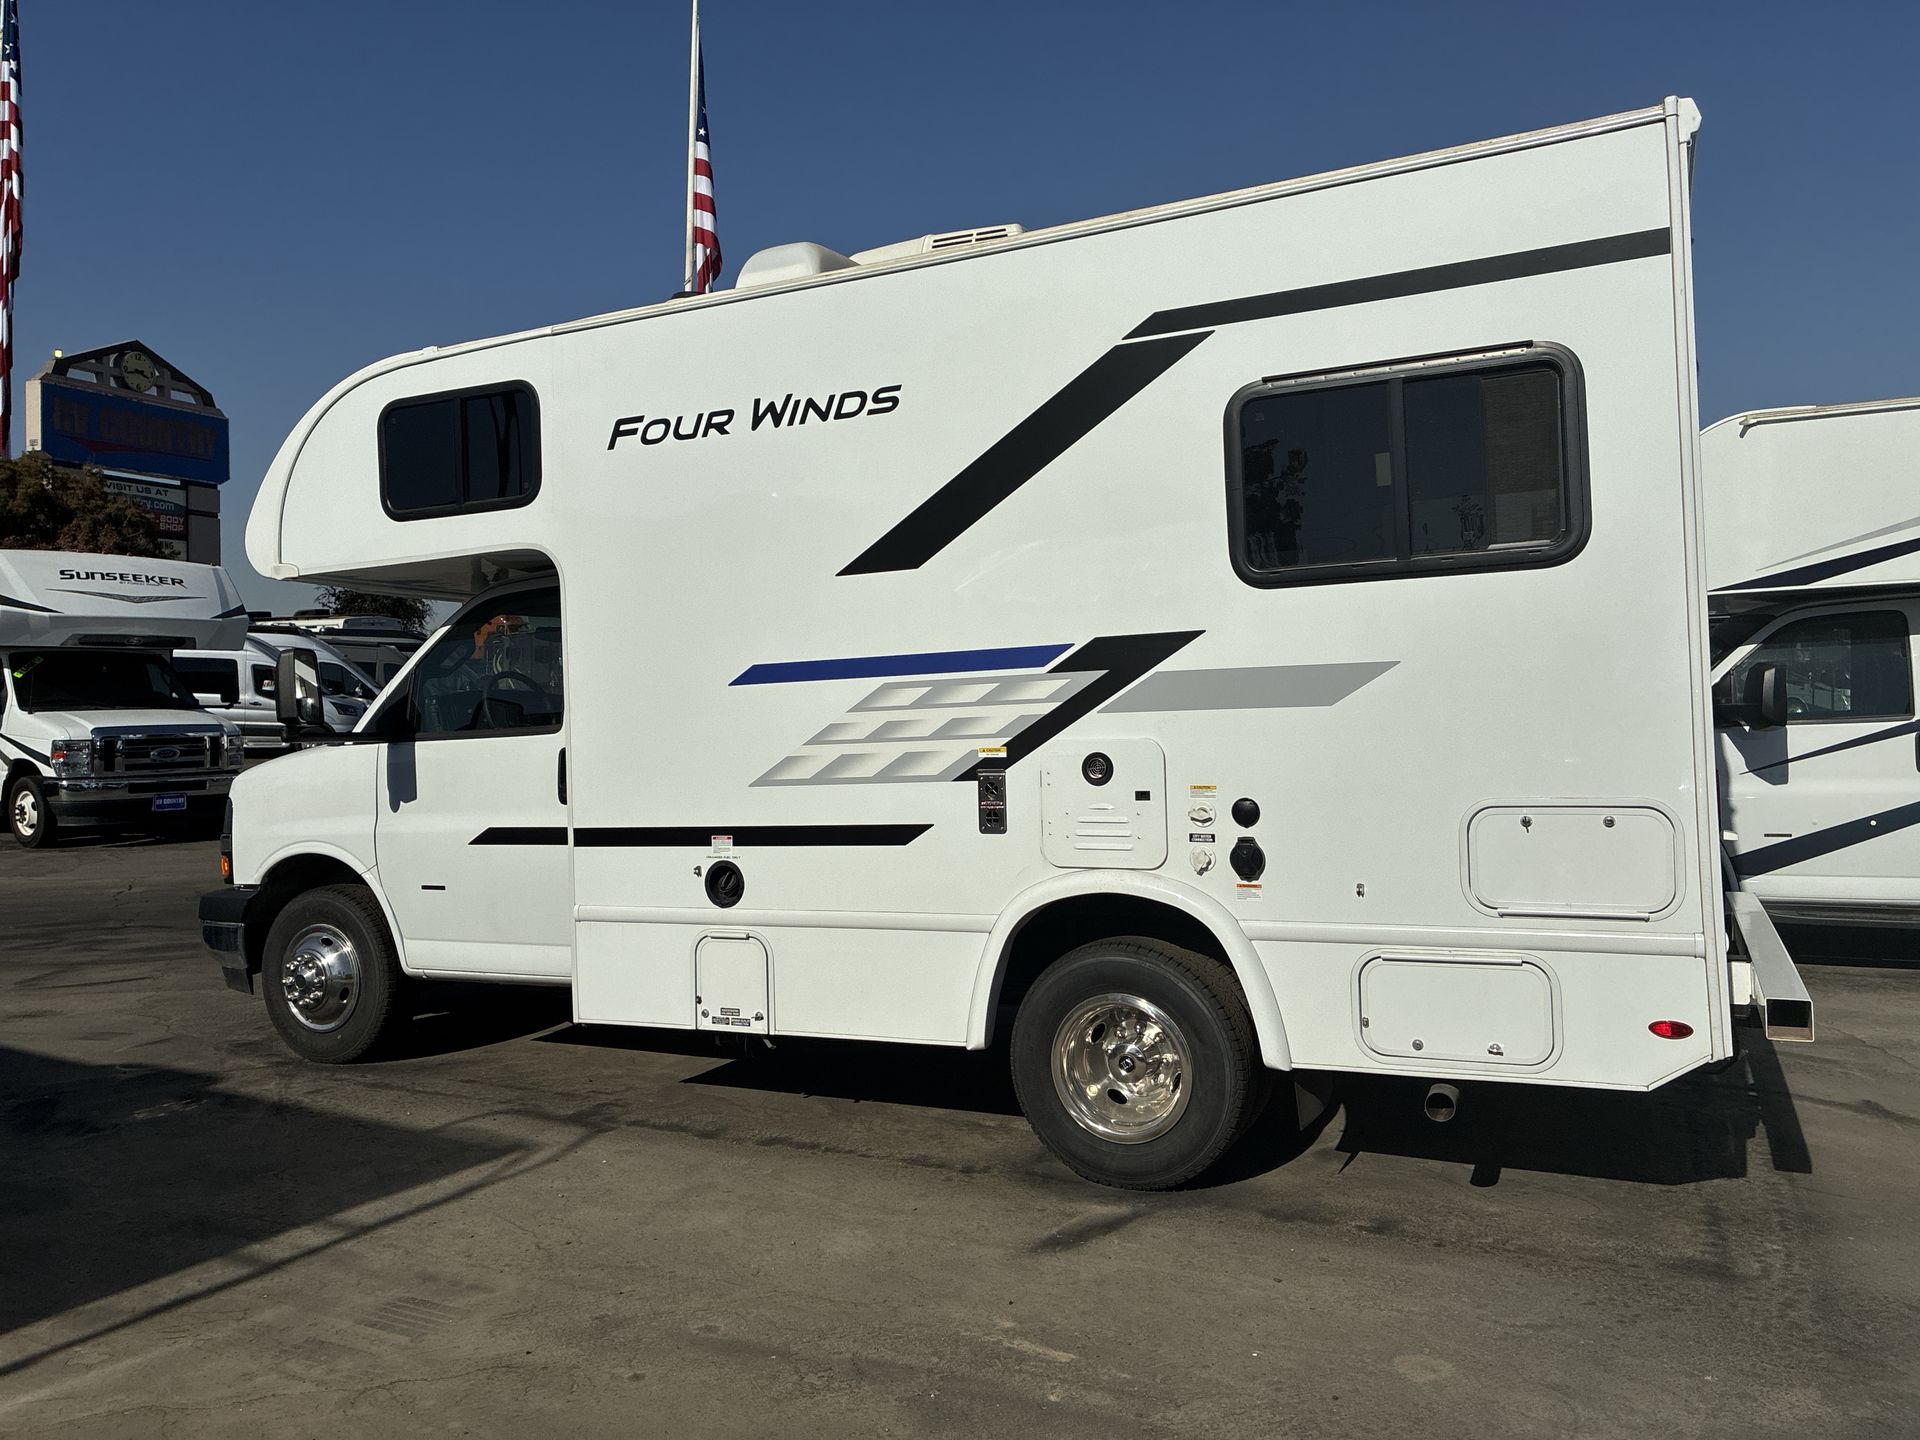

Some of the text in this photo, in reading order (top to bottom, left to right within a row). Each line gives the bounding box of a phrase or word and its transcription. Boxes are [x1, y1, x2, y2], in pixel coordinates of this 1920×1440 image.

[607, 384, 902, 451] FOUR WINDS
[105, 482, 169, 497] VISIT US AT
